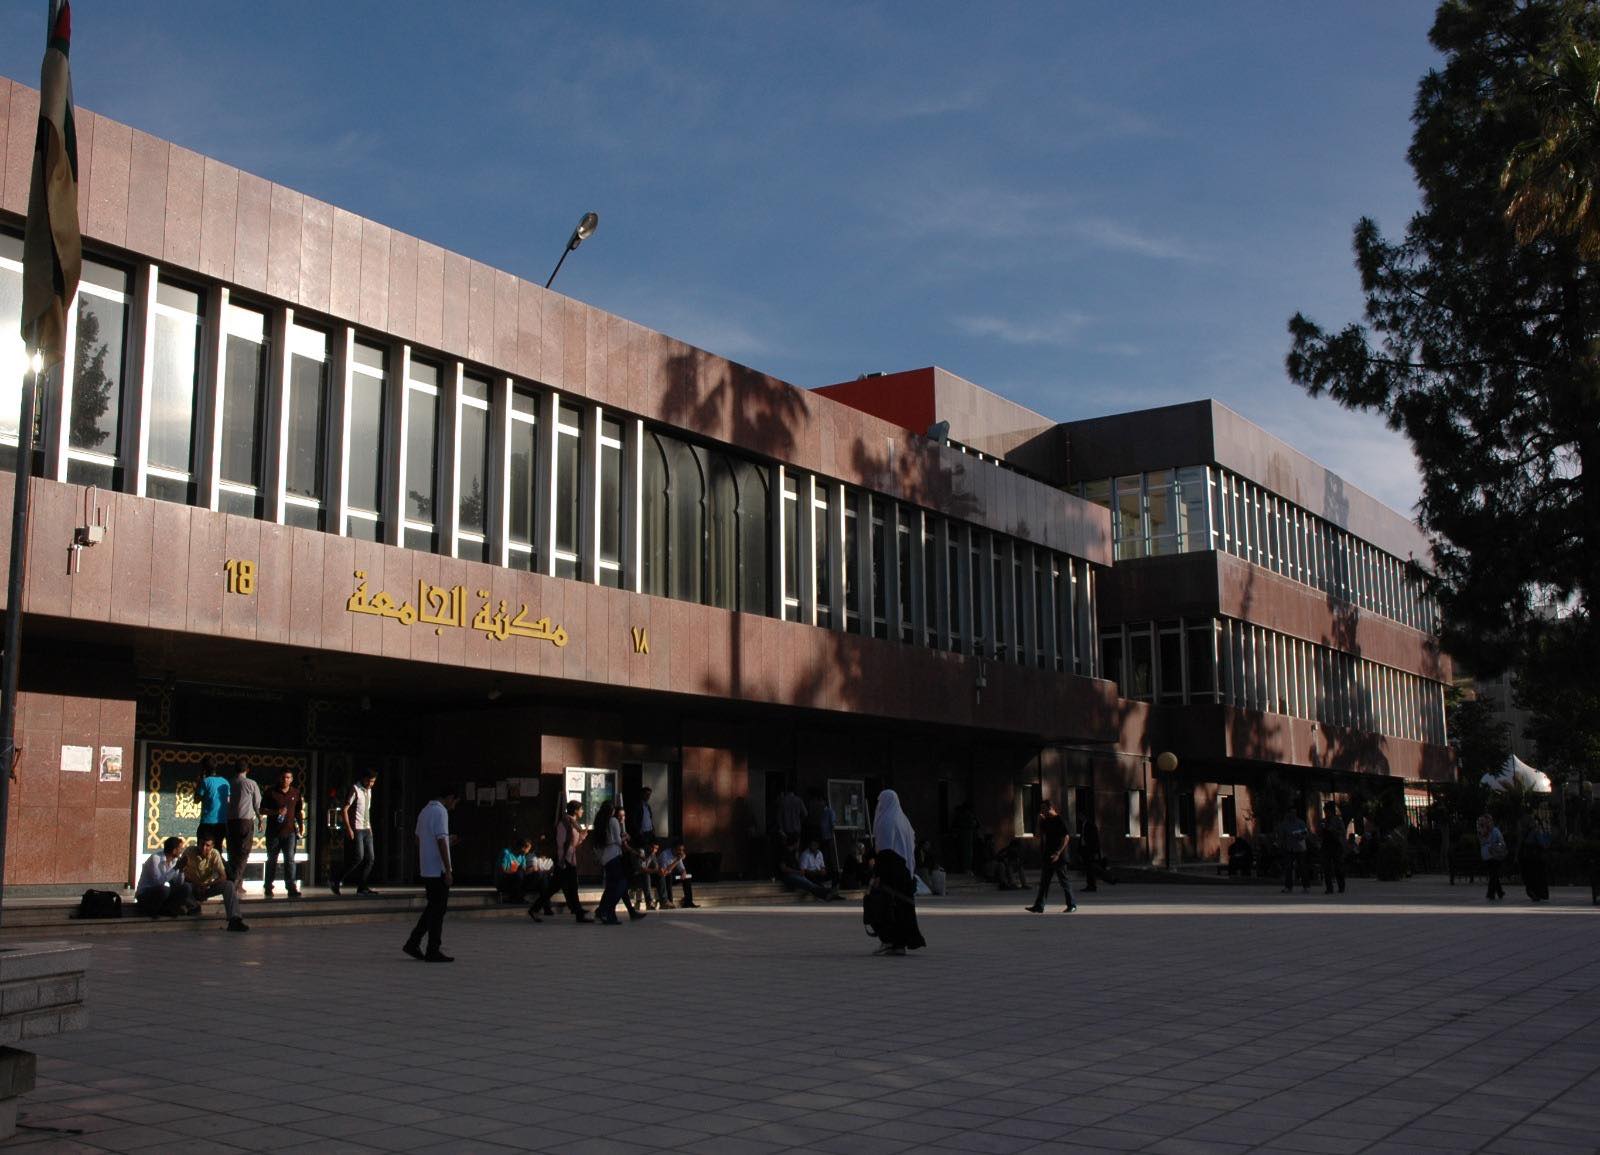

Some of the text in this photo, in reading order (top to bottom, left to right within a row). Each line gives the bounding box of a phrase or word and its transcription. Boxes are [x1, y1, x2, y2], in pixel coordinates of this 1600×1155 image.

[224, 559, 255, 595] 18
[347, 571, 568, 647] مكتبة الجامعة
